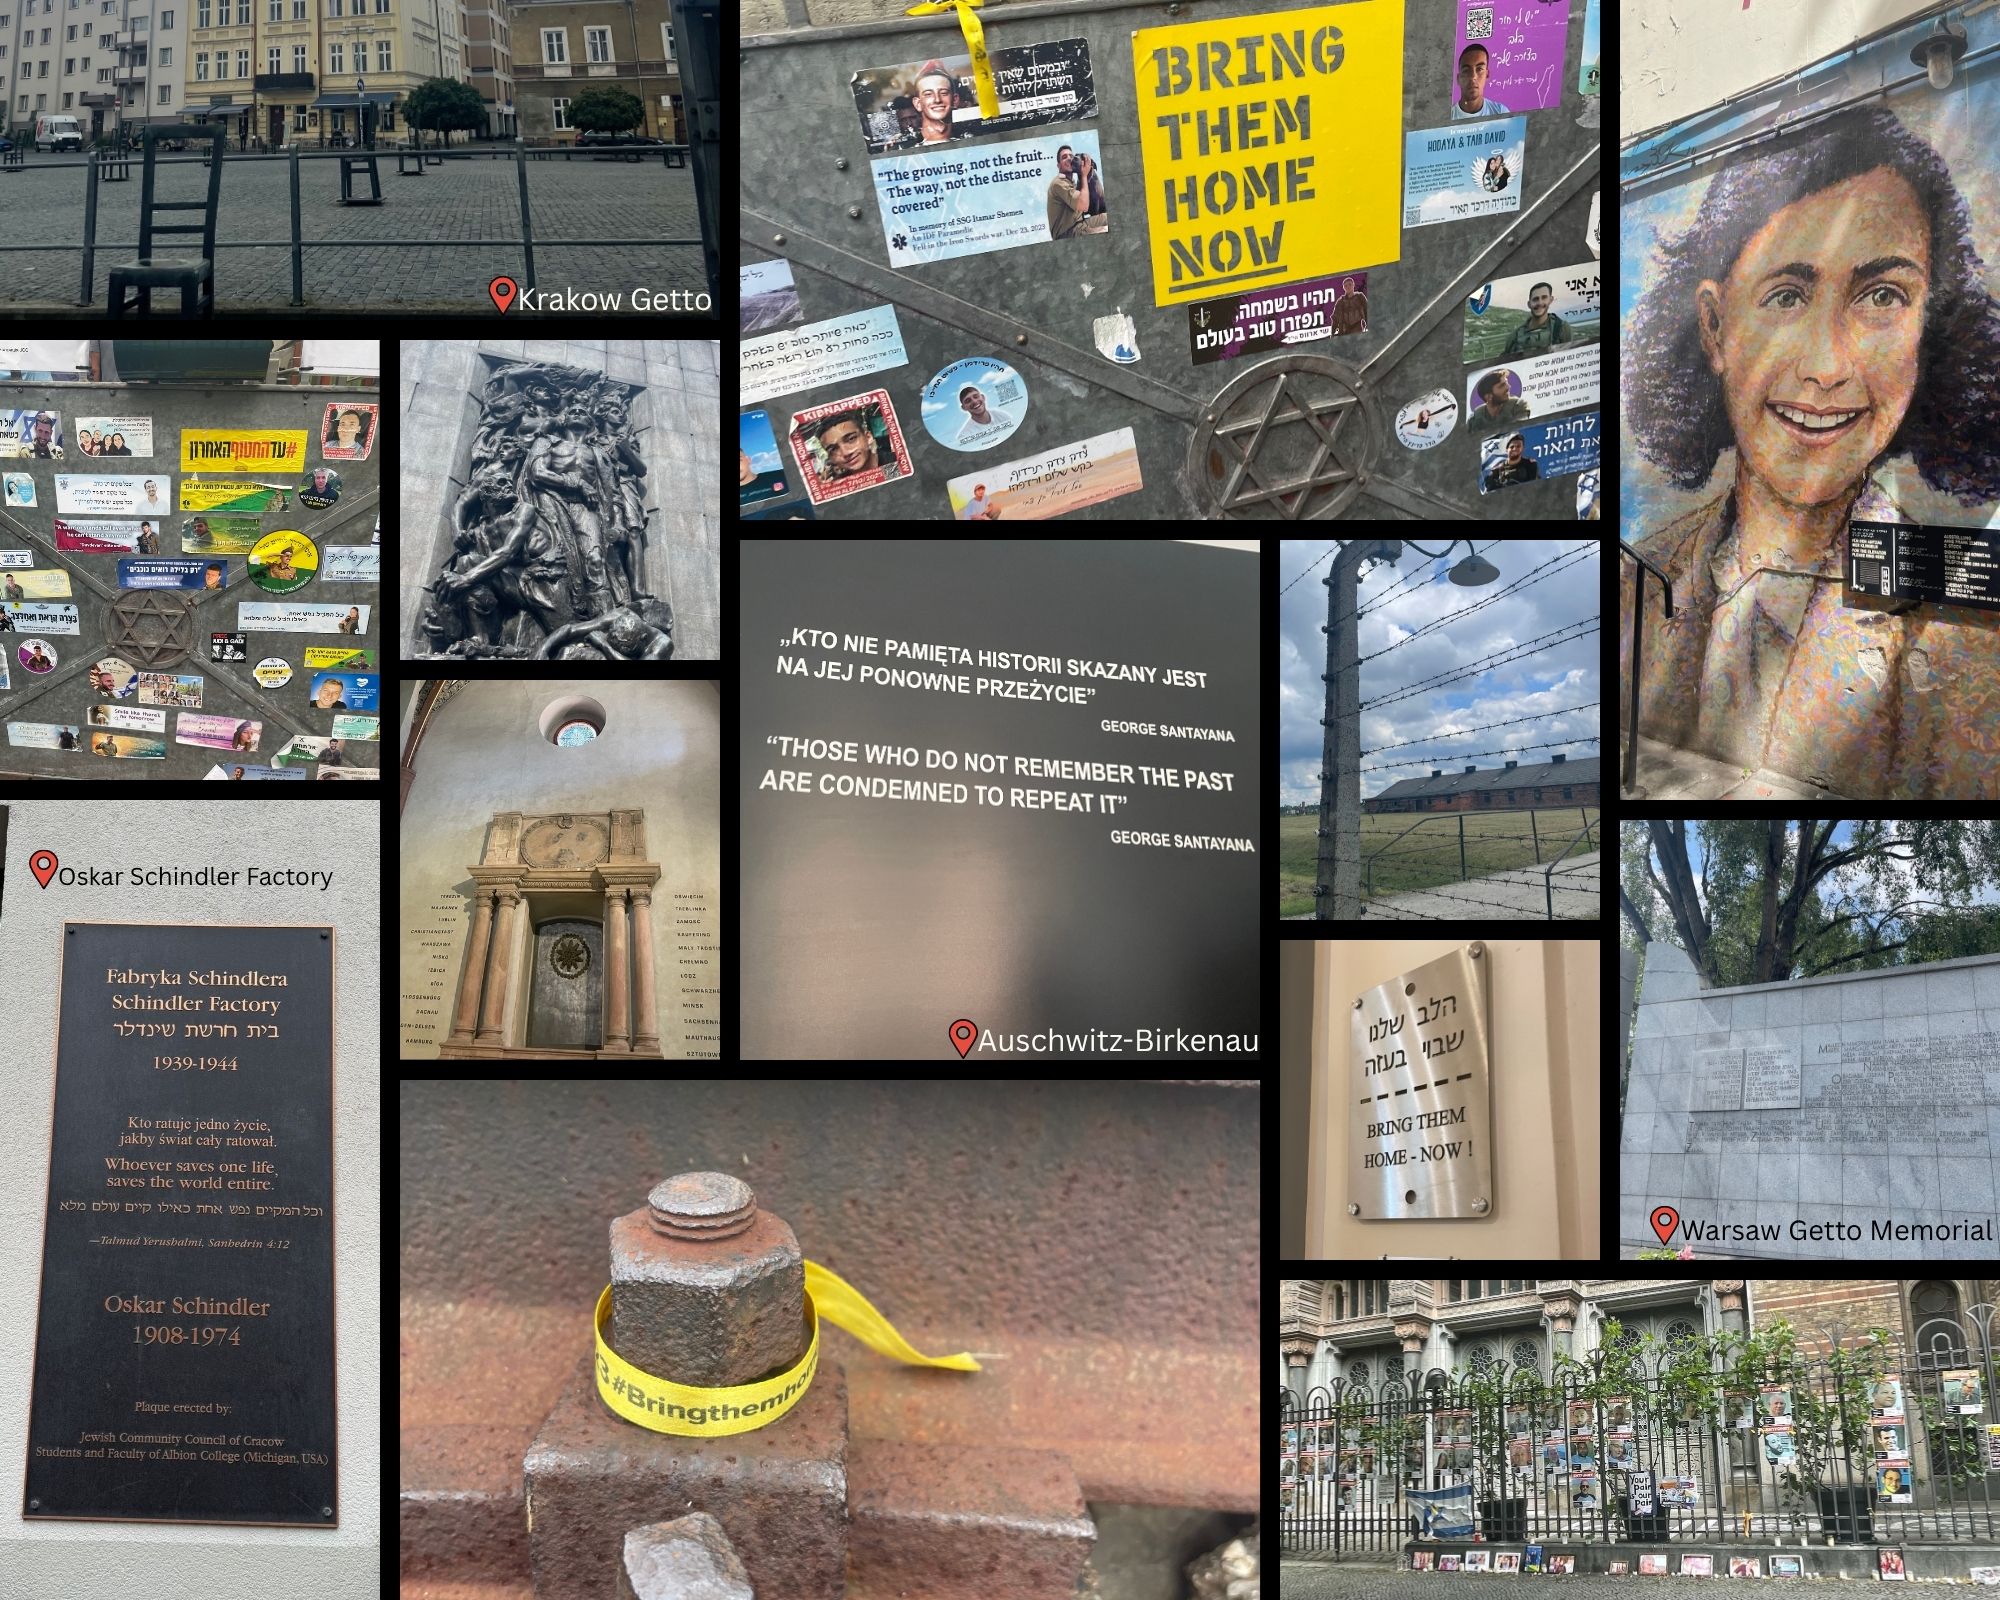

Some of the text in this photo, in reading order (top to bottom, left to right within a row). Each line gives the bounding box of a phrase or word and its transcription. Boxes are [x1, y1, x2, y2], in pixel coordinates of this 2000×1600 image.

[1153, 25, 1345, 98] BRING
[1157, 94, 1311, 161] THEM
[1427, 130, 1506, 152] HODAYA & TAIR DAVID
[912, 163, 968, 182] growing,
[970, 159, 991, 171] not
[993, 156, 1013, 168] the
[1015, 149, 1054, 164] fruit...
[886, 167, 1042, 199] The way, not the distance
[1164, 156, 1315, 223] HOME
[909, 208, 1023, 233] In memory of SSG Itamar Shemen
[938, 226, 974, 239] Paramedic
[936, 239, 947, 248] the
[965, 232, 989, 244] Swords
[1031, 223, 1046, 232] 2023
[1169, 220, 1286, 282] NOW
[1235, 288, 1335, 323] תהיו בשמחה,
[1196, 311, 1324, 350] תפזרו טוב בעולם
[803, 396, 872, 422] KIDNAPPED
[1545, 415, 1596, 440] לחיות
[1532, 438, 1575, 458] האור
[780, 628, 1207, 689] „KTO NIE PAMIĘTA HISTORII SKAZANY JEST
[776, 655, 1097, 705] NA JEJ PONOWNE PRZEŻYCIE”
[1101, 719, 1236, 743] GEORGE SANTAYANA
[767, 736, 1235, 792] “THOSE WHO DO NOT REMEMBER THE PAST
[759, 769, 1128, 815] ARE CONDEMNED TO REPEAT IT”
[1111, 830, 1255, 852] GEORGE SANTAYANA
[107, 968, 288, 988] Fabryka Schindlera
[112, 995, 281, 1016] Schindler Factory
[113, 1022, 280, 1038] בית חרשת שינדלר
[1370, 995, 1457, 1043] הלב שלנו
[153, 1056, 238, 1071] 1939-1944
[1365, 1030, 1465, 1078] שבוי בעזה
[128, 1117, 271, 1133] Kto ratuje jedno życie,
[1367, 1106, 1466, 1139] BRING THEM
[119, 1132, 277, 1149] jakby świat cały ratował.
[1364, 1142, 1462, 1169] HOME NOW
[105, 1158, 279, 1178] Whoever saves one life,
[106, 1176, 275, 1191] saves the world entire.
[60, 1200, 323, 1218] וכל המקיים נפש אחת כאילו קיים עולם מלא
[143, 1236, 204, 1248] Yerushalmi,
[208, 1238, 263, 1249] Sanhedrin
[266, 1240, 290, 1249] 4:12
[105, 1295, 271, 1317] Oskar Schindler
[133, 1326, 241, 1347] 1908-1974
[135, 1402, 232, 1416] Plaque erected by:
[80, 1432, 285, 1447] Jewish Community Council of Cracow
[36, 1446, 329, 1466] Students and Faculty of Albion College (Michigan, USA)
[1630, 1475, 1649, 1486] Your
